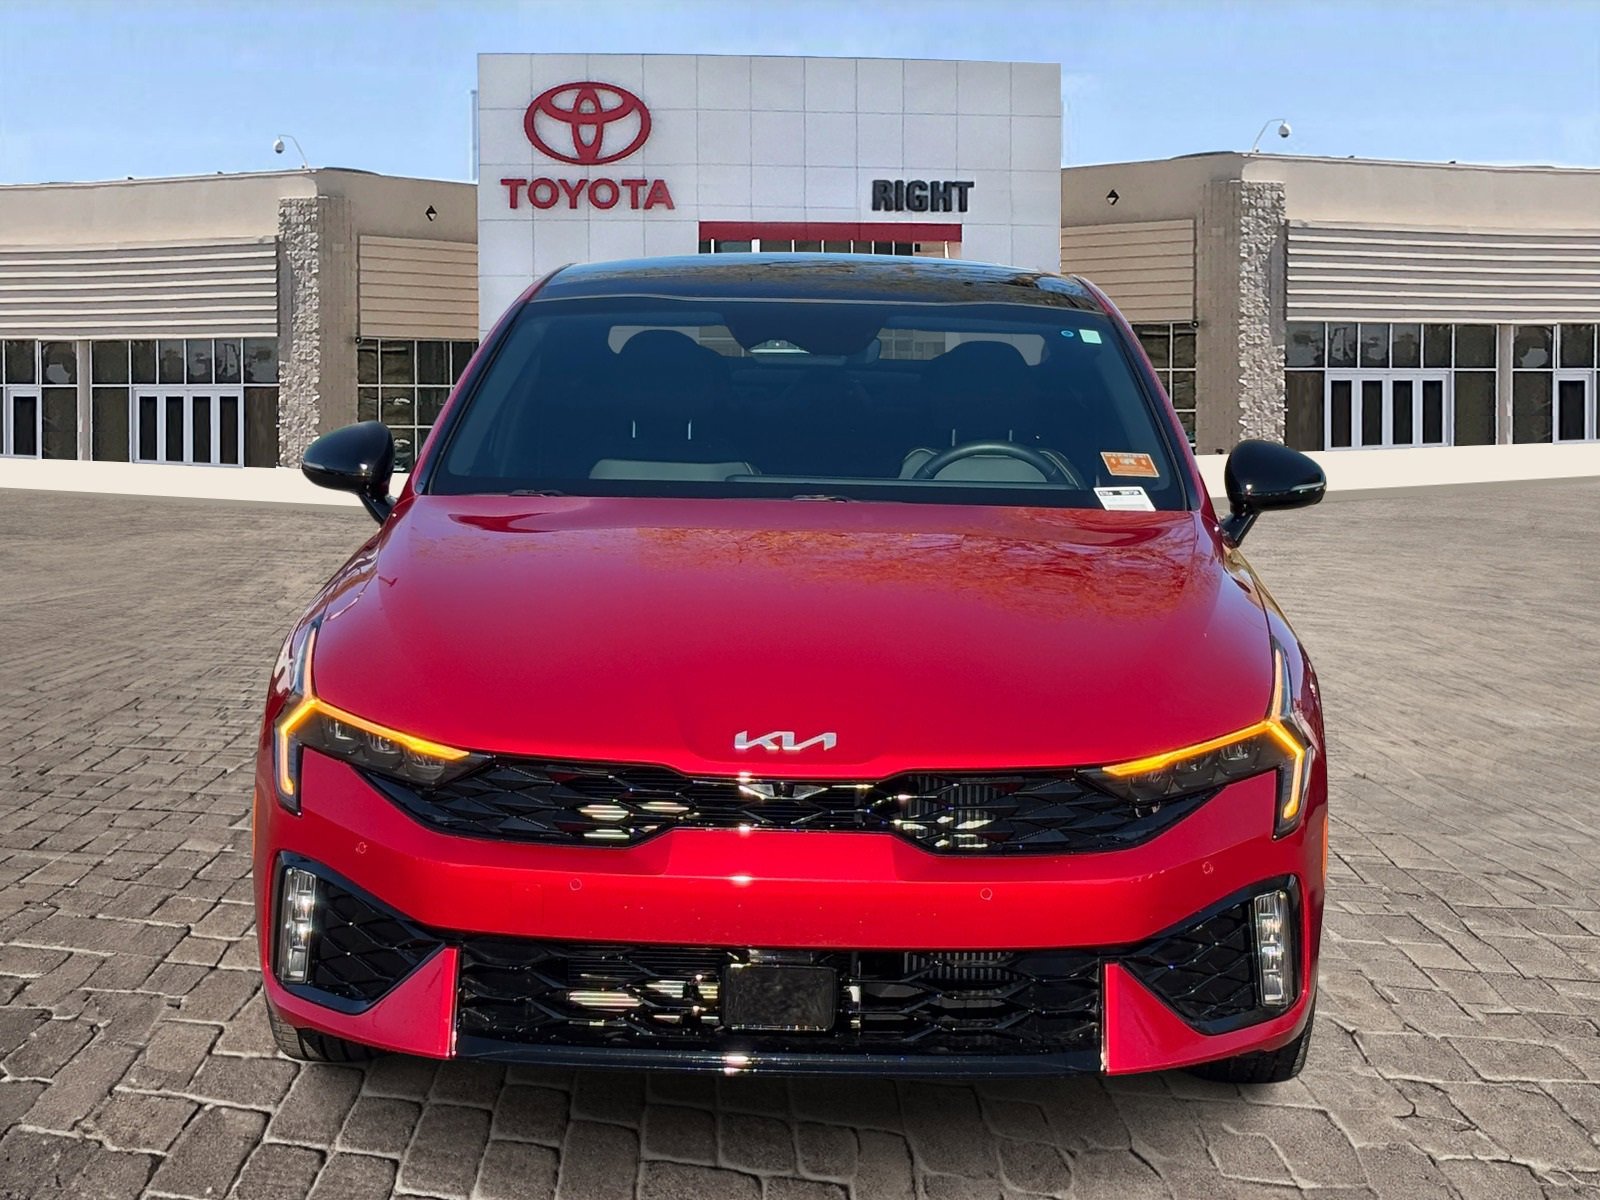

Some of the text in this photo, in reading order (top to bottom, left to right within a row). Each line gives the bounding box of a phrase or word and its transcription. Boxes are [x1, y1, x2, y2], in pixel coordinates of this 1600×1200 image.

[500, 177, 675, 210] TOYOTA
[872, 179, 975, 212] RIGHT
[734, 730, 837, 751] KIA
